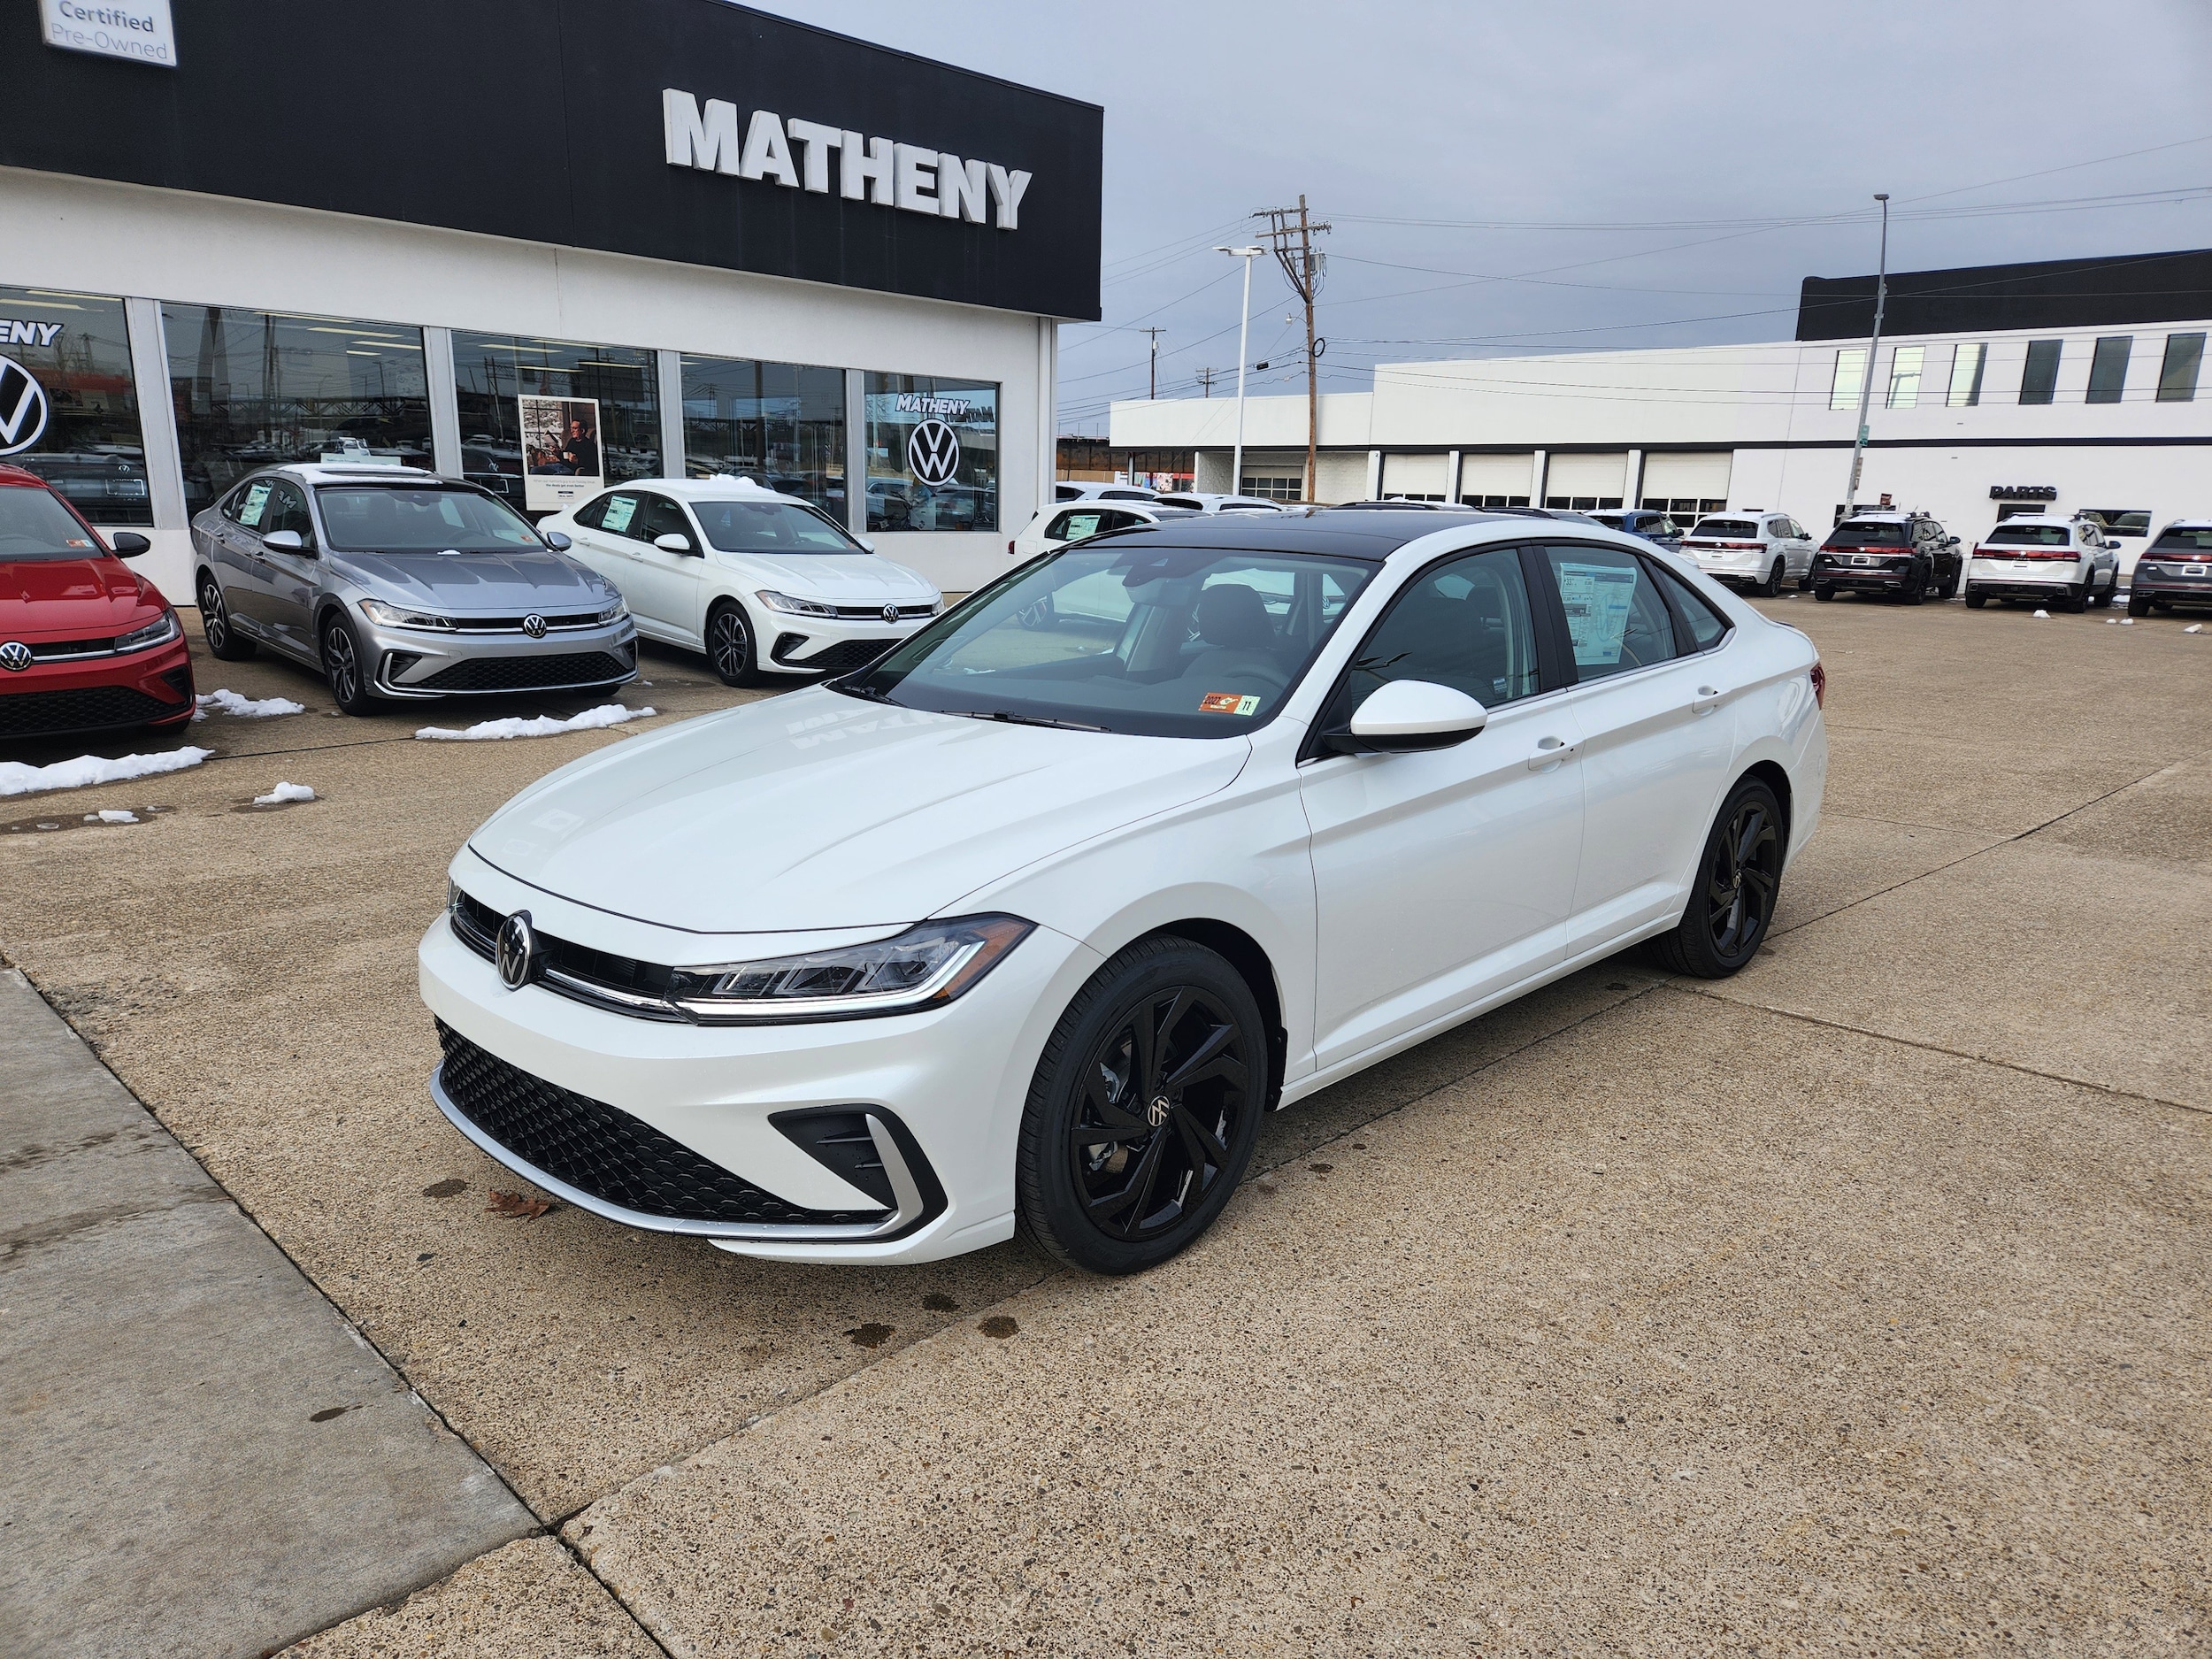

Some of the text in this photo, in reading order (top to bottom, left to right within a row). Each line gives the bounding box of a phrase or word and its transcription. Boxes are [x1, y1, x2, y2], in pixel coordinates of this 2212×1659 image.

[58, 1, 154, 33] Certified
[51, 23, 167, 59] Pre-Owned
[662, 88, 1033, 230] MATHENY
[895, 393, 971, 415] MATHENY
[1989, 486, 2057, 501] PARTS
[1242, 701, 1252, 711] 11
